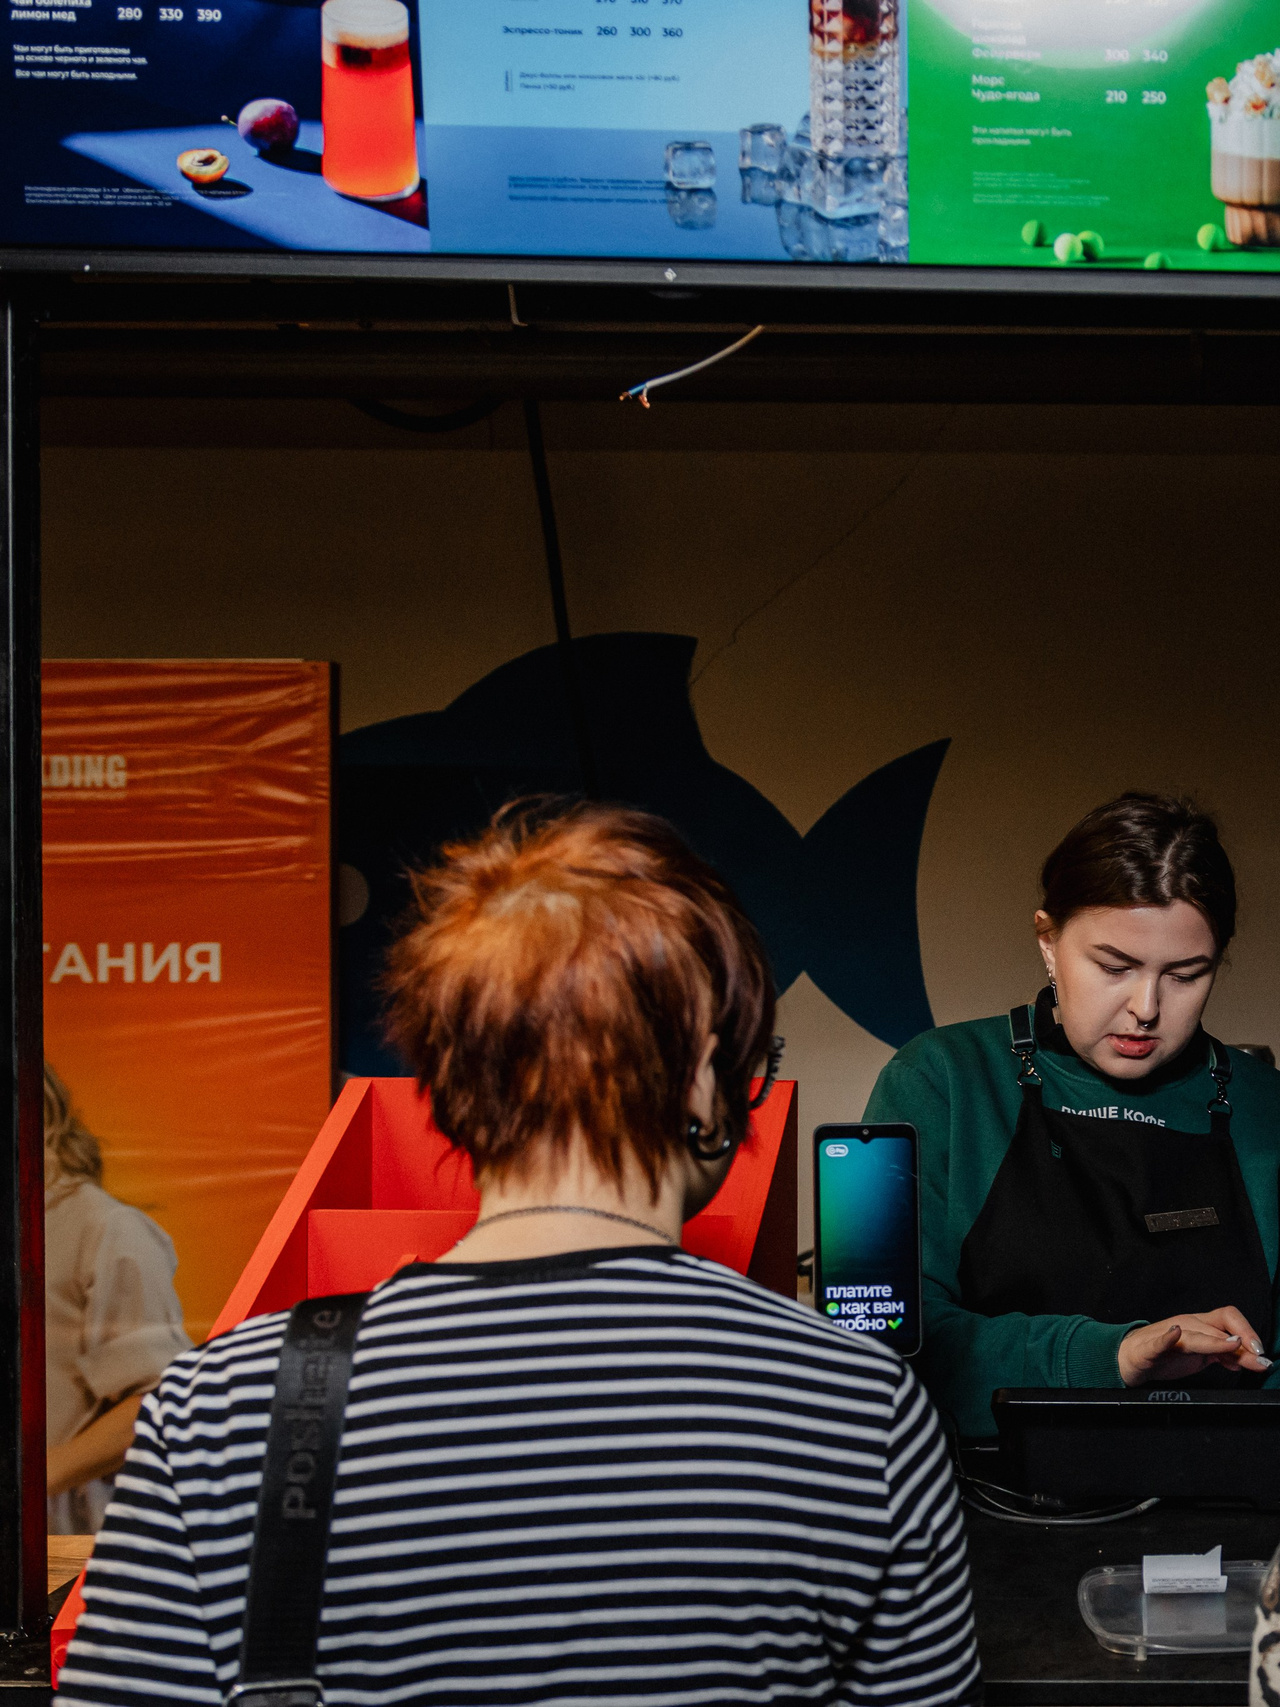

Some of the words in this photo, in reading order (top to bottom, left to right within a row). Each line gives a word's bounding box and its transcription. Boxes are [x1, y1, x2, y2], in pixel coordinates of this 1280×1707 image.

[11, 10, 50, 20] лимон
[52, 11, 77, 22] мед
[117, 7, 142, 20] 280
[159, 8, 183, 21] 330
[197, 8, 222, 22] 390
[502, 25, 583, 35] Эспрессо-тоник
[596, 26, 617, 36] 260
[630, 26, 651, 37] 300
[662, 27, 683, 37] 360
[30, 46, 53, 54] могут
[54, 44, 73, 53] быть
[1104, 48, 1131, 62] 300
[1142, 49, 1169, 63] 340
[15, 69, 30, 78] Все
[47, 70, 69, 80] могут
[70, 70, 90, 79] быть
[972, 74, 1005, 87] Морс
[971, 88, 1040, 102] Чудо-ягода
[1105, 89, 1128, 103] 210
[1142, 90, 1167, 104] 250
[43, 941, 222, 984] АНИЯ
[826, 1285, 893, 1299] платите
[841, 1302, 871, 1315] как
[873, 1301, 904, 1314] вам
[833, 1314, 887, 1331] добно
